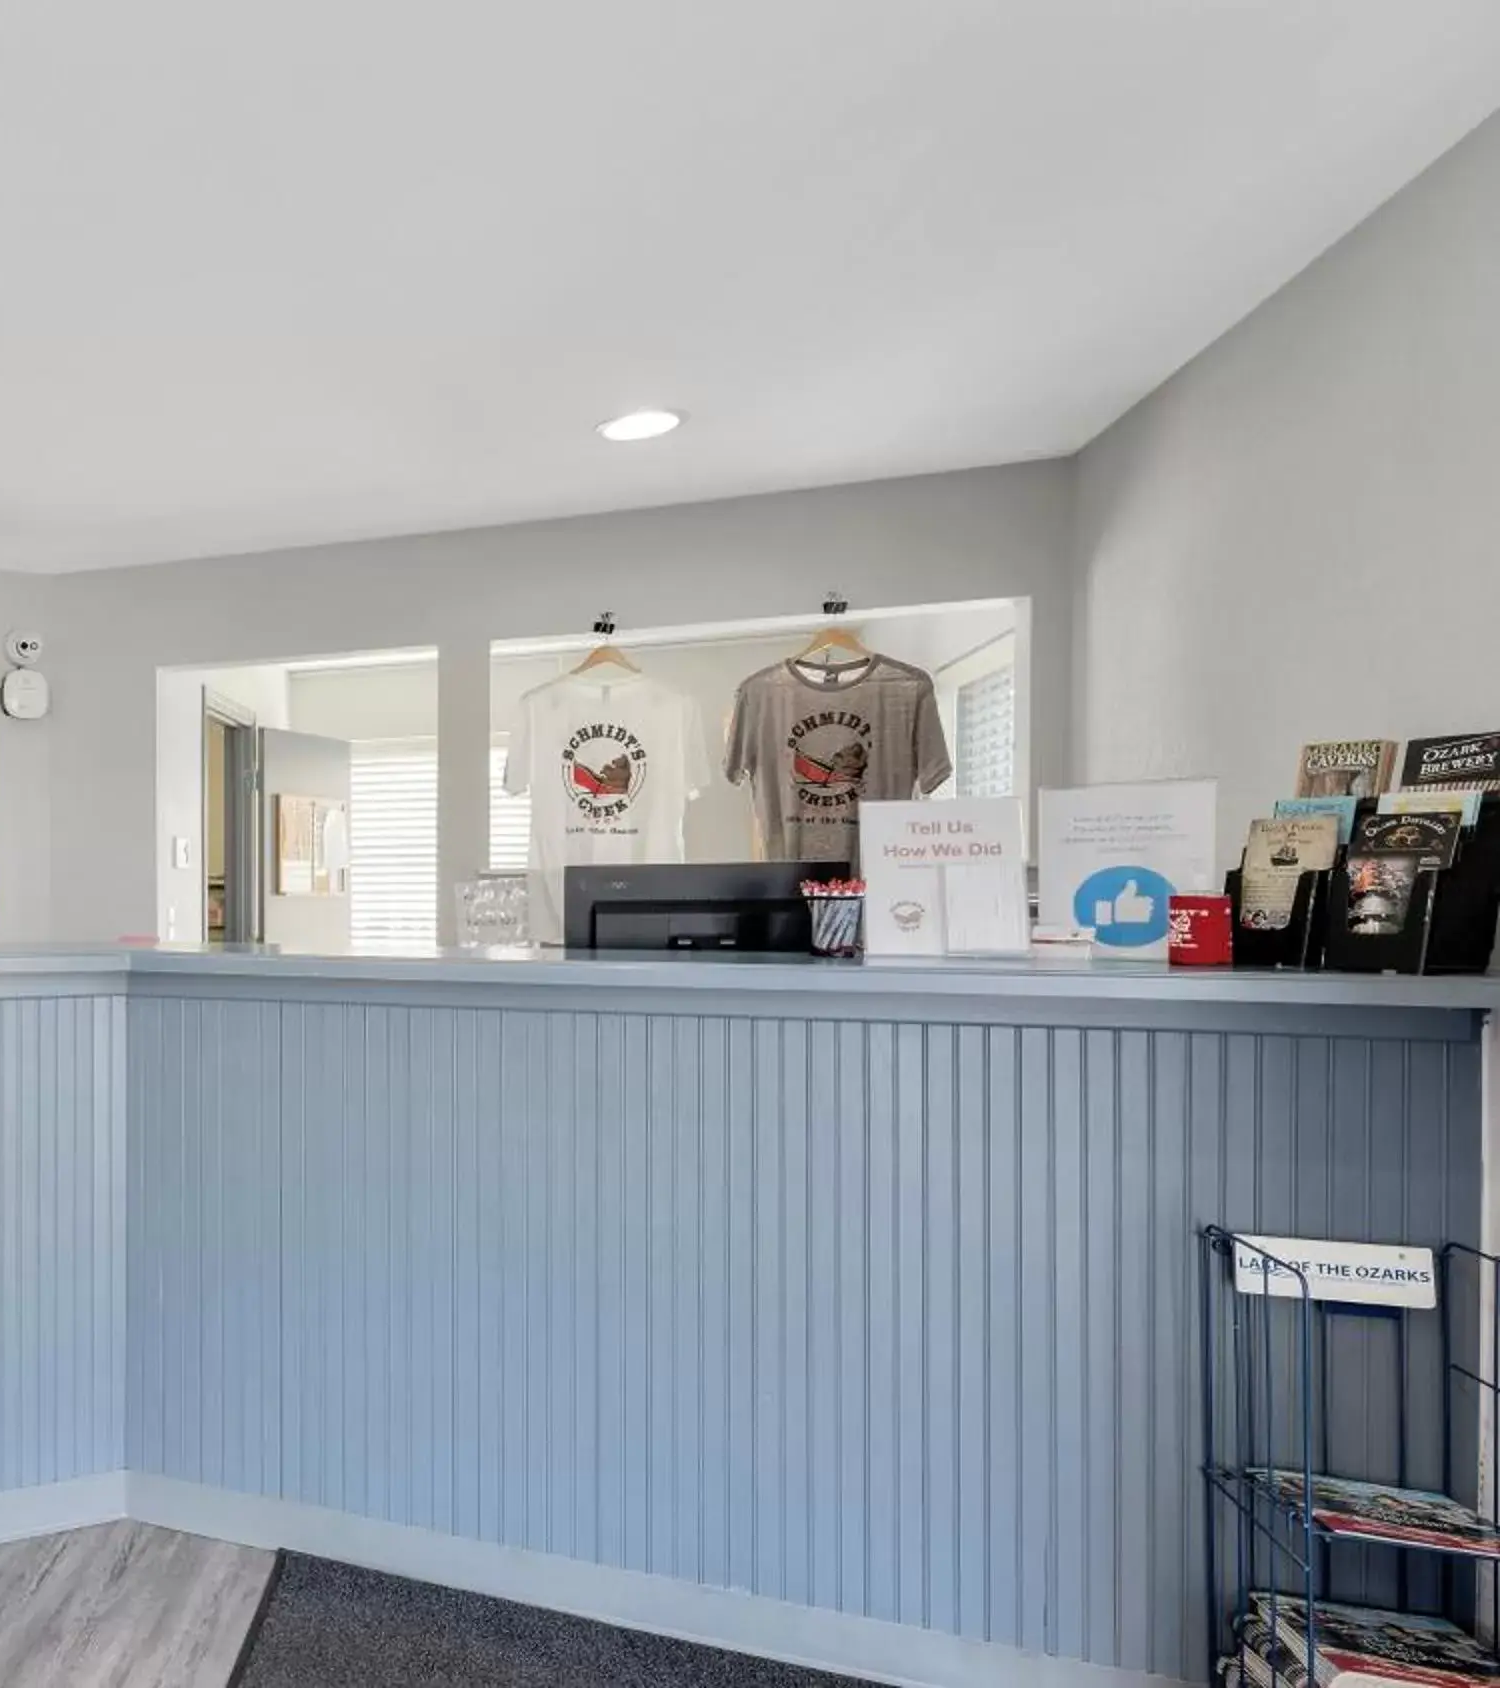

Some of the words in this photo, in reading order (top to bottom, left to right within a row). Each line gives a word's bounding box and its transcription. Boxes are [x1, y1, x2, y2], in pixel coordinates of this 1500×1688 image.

[562, 724, 646, 761] SCHMIDT'S
[1307, 752, 1378, 770] CAVERNS
[1422, 743, 1483, 763] OZARK
[1420, 752, 1497, 776] BREWERY
[909, 822, 941, 834] Tell
[947, 821, 974, 834] Us
[883, 844, 926, 857] How
[932, 844, 963, 857] We
[969, 842, 1002, 857] Did
[1316, 1263, 1350, 1277] THE
[1356, 1267, 1431, 1283] OZARKS
